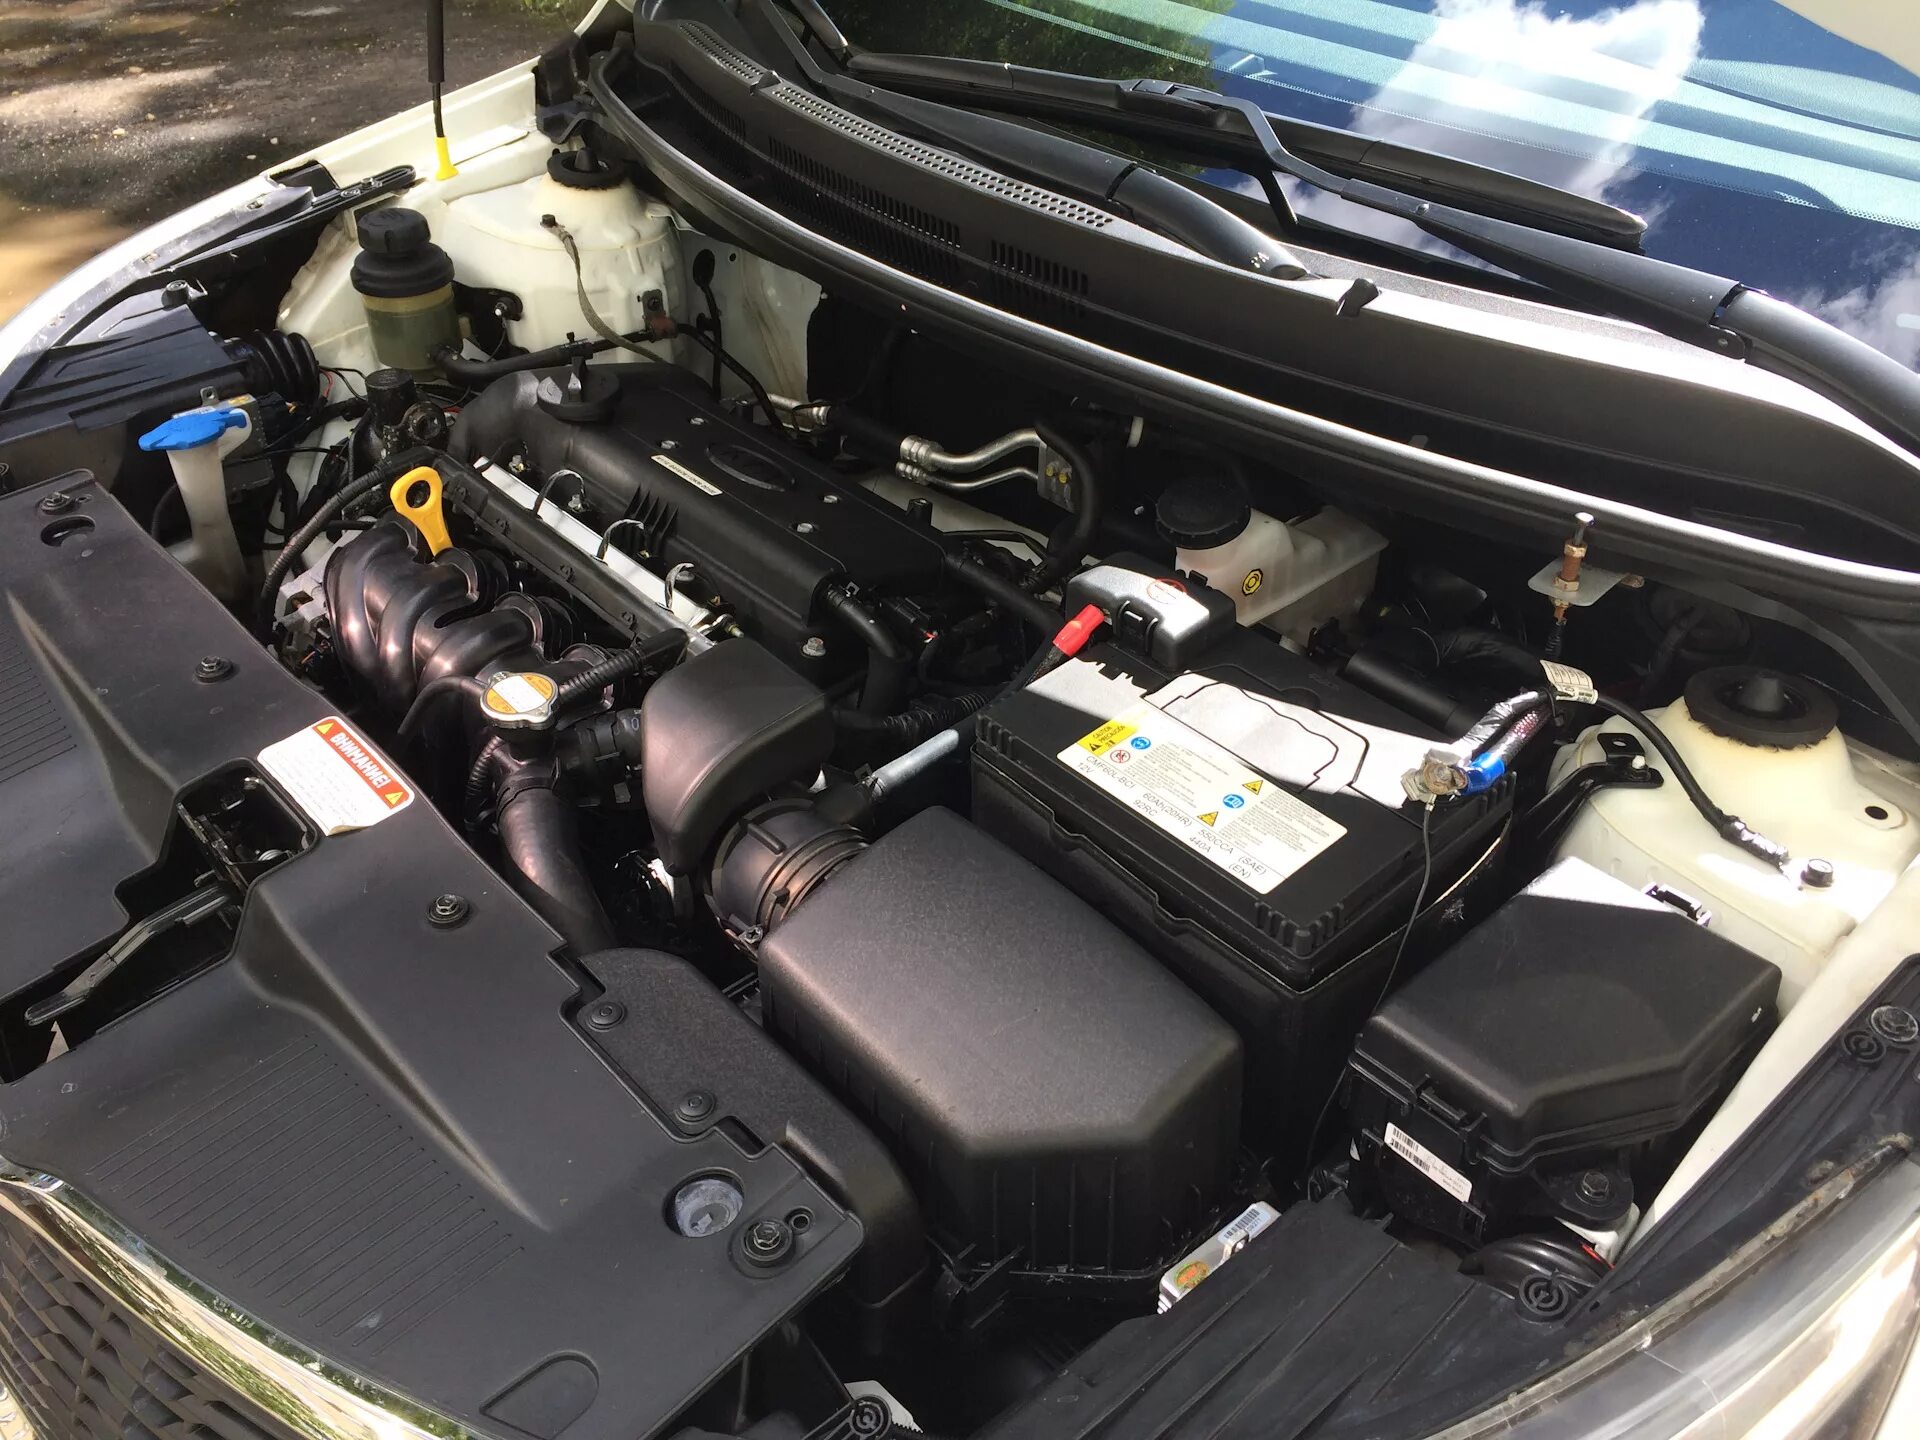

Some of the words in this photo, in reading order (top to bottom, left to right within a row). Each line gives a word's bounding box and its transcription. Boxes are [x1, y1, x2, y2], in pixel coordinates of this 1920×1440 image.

[329, 731, 392, 789] ВНИМАНИЕ!
[1077, 762, 1095, 773] 12V
[1132, 799, 1158, 817] 92RC
[1189, 836, 1212, 853] 440A
[1228, 862, 1252, 879] (EN)
[1142, 792, 1193, 828] 60Ah(20HR)
[1198, 829, 1234, 854] 550CCA
[1238, 856, 1267, 875] (SAE)
